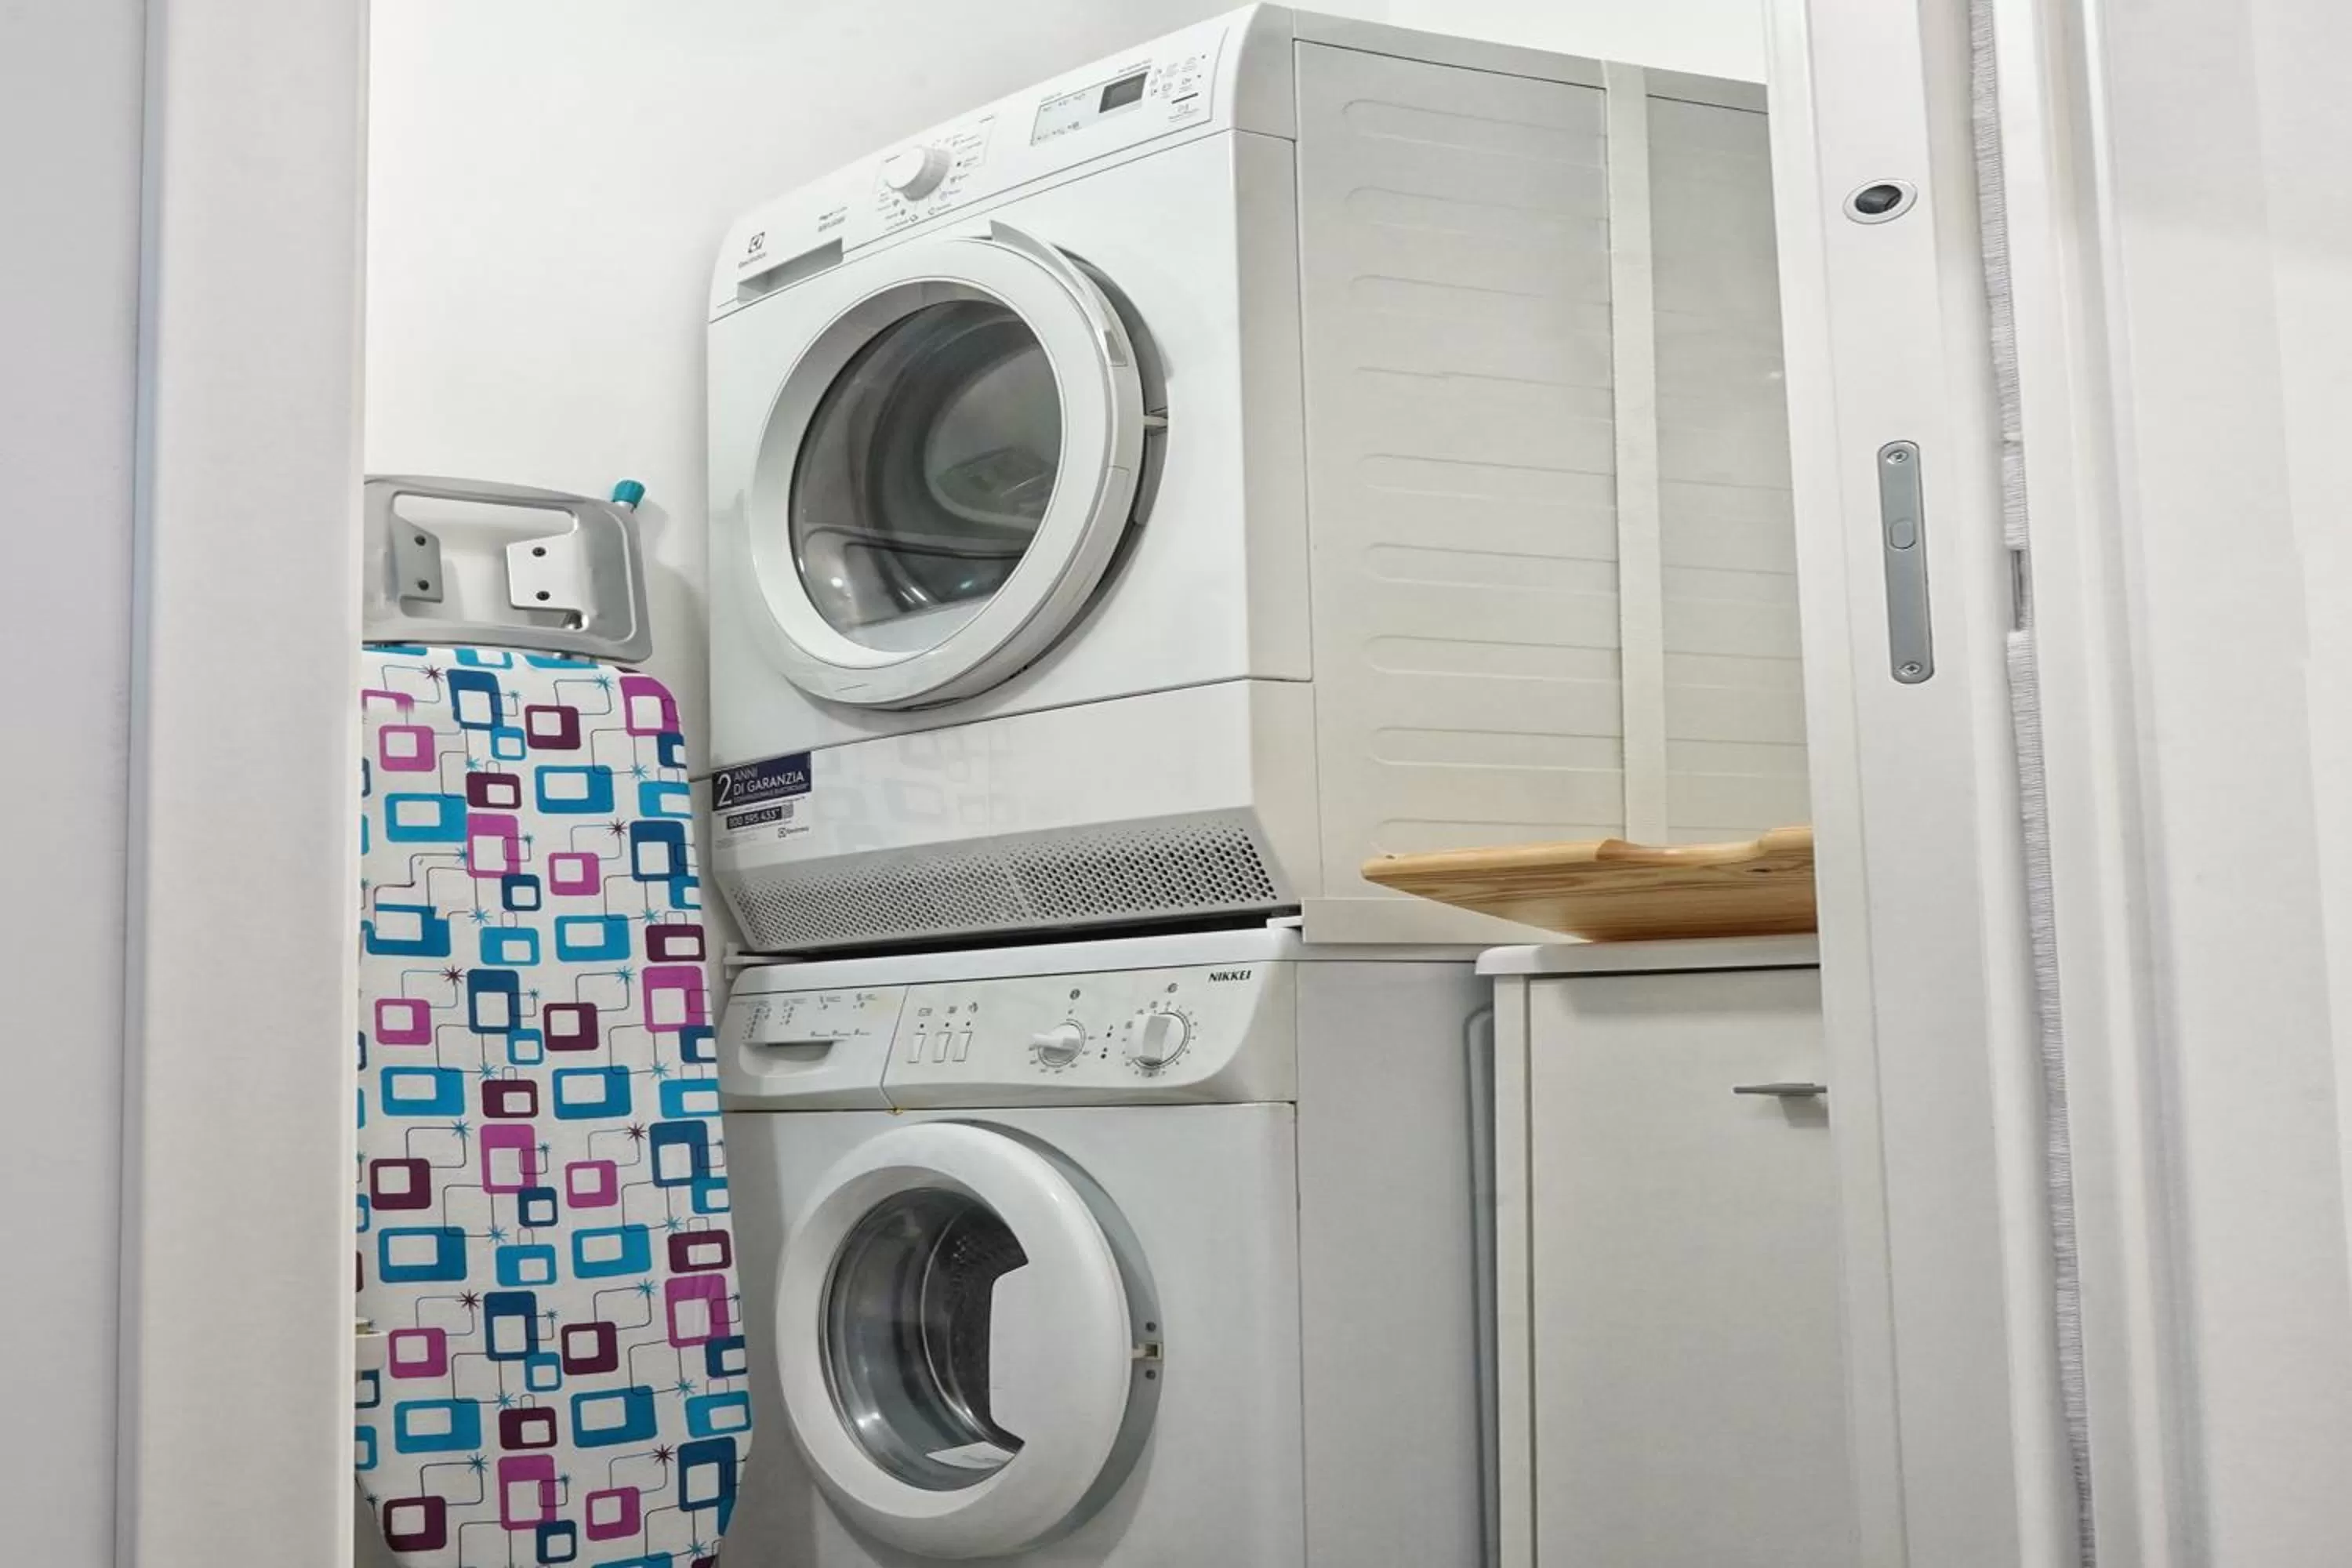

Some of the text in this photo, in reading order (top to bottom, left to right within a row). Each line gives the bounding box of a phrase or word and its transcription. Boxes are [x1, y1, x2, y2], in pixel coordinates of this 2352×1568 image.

[717, 772, 733, 807] 2
[733, 783, 744, 796] DI
[746, 771, 805, 793] GARANZIA
[1207, 970, 1252, 982] NIKKEI
